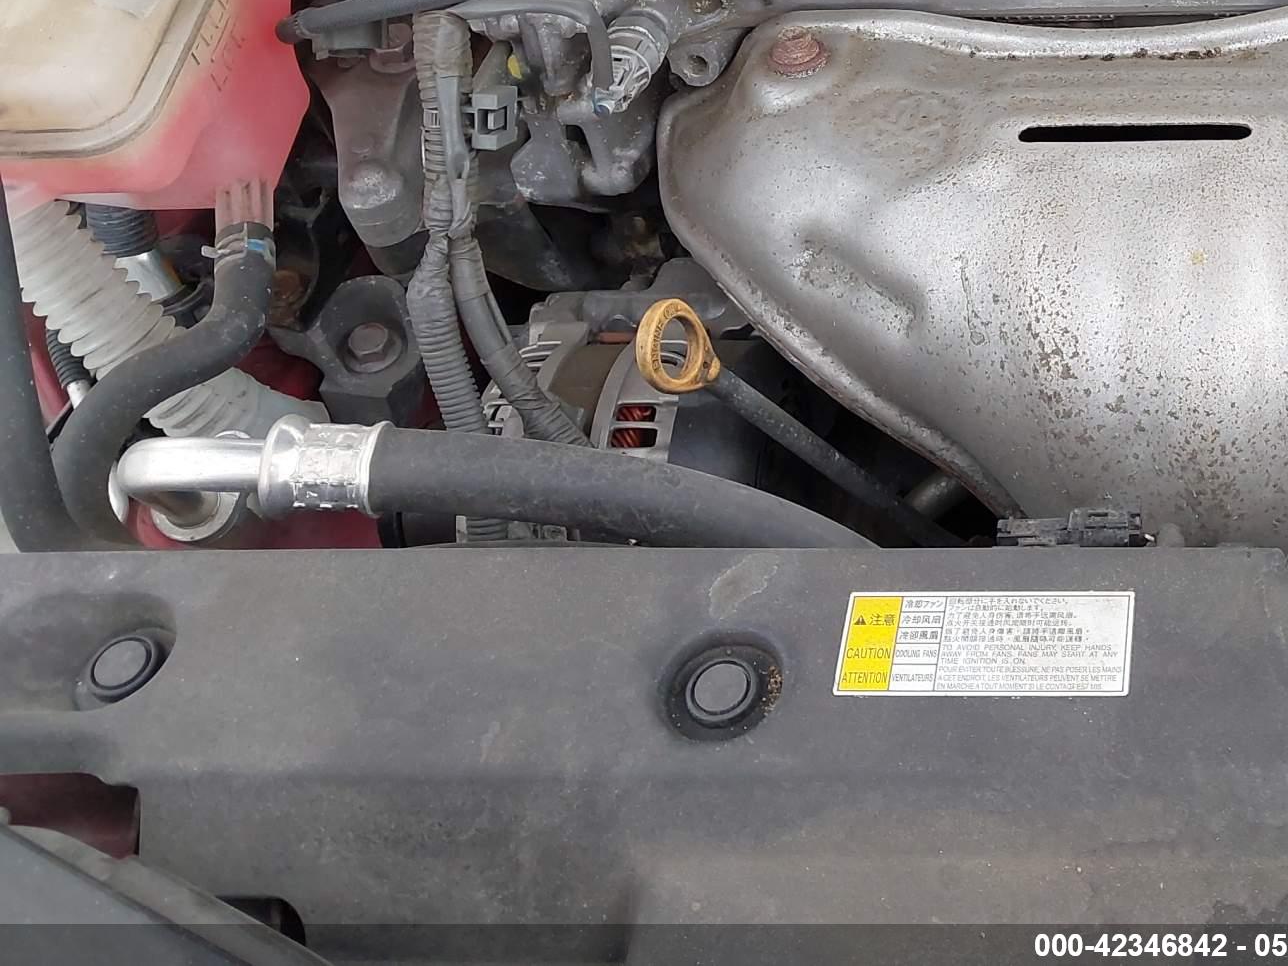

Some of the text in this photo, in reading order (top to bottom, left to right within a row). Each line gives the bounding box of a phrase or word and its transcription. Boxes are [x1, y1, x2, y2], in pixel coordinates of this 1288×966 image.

[904, 599, 944, 609] 冷却ファン
[869, 614, 896, 626] 注意
[902, 615, 942, 624] 冷却风扇
[846, 648, 891, 659] CAUTION
[895, 649, 938, 658] COOLING FANS
[842, 672, 888, 684] ATTENTION
[892, 674, 934, 682] VENTILATEURS
